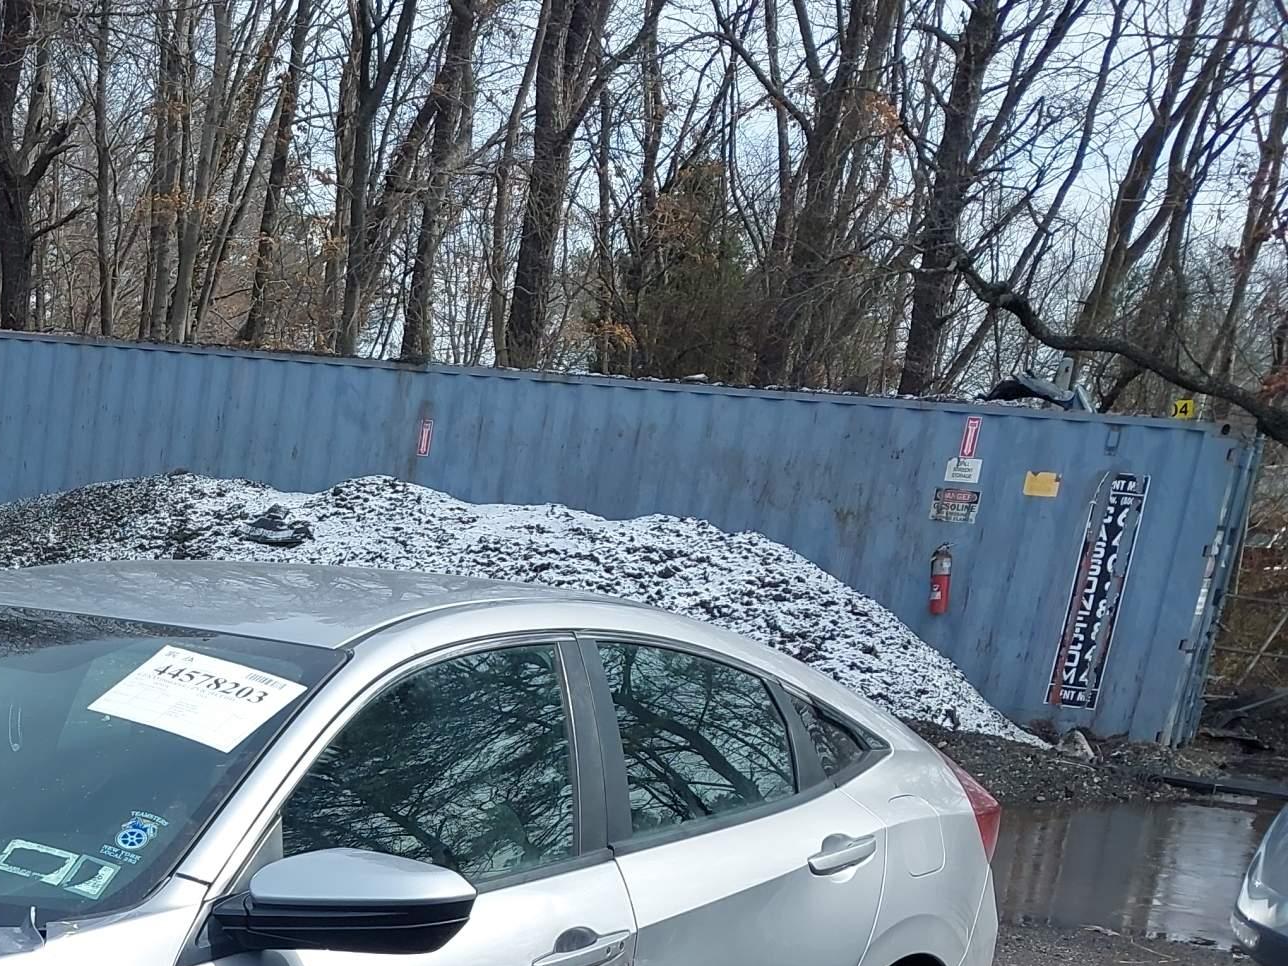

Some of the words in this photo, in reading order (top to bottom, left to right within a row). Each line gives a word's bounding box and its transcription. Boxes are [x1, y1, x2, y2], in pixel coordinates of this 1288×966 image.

[933, 502, 977, 513] GSOLINE
[154, 664, 269, 704] 44578203
[99, 849, 122, 860] LOCAL
[102, 844, 121, 854] NEW
[121, 850, 142, 861] YORK
